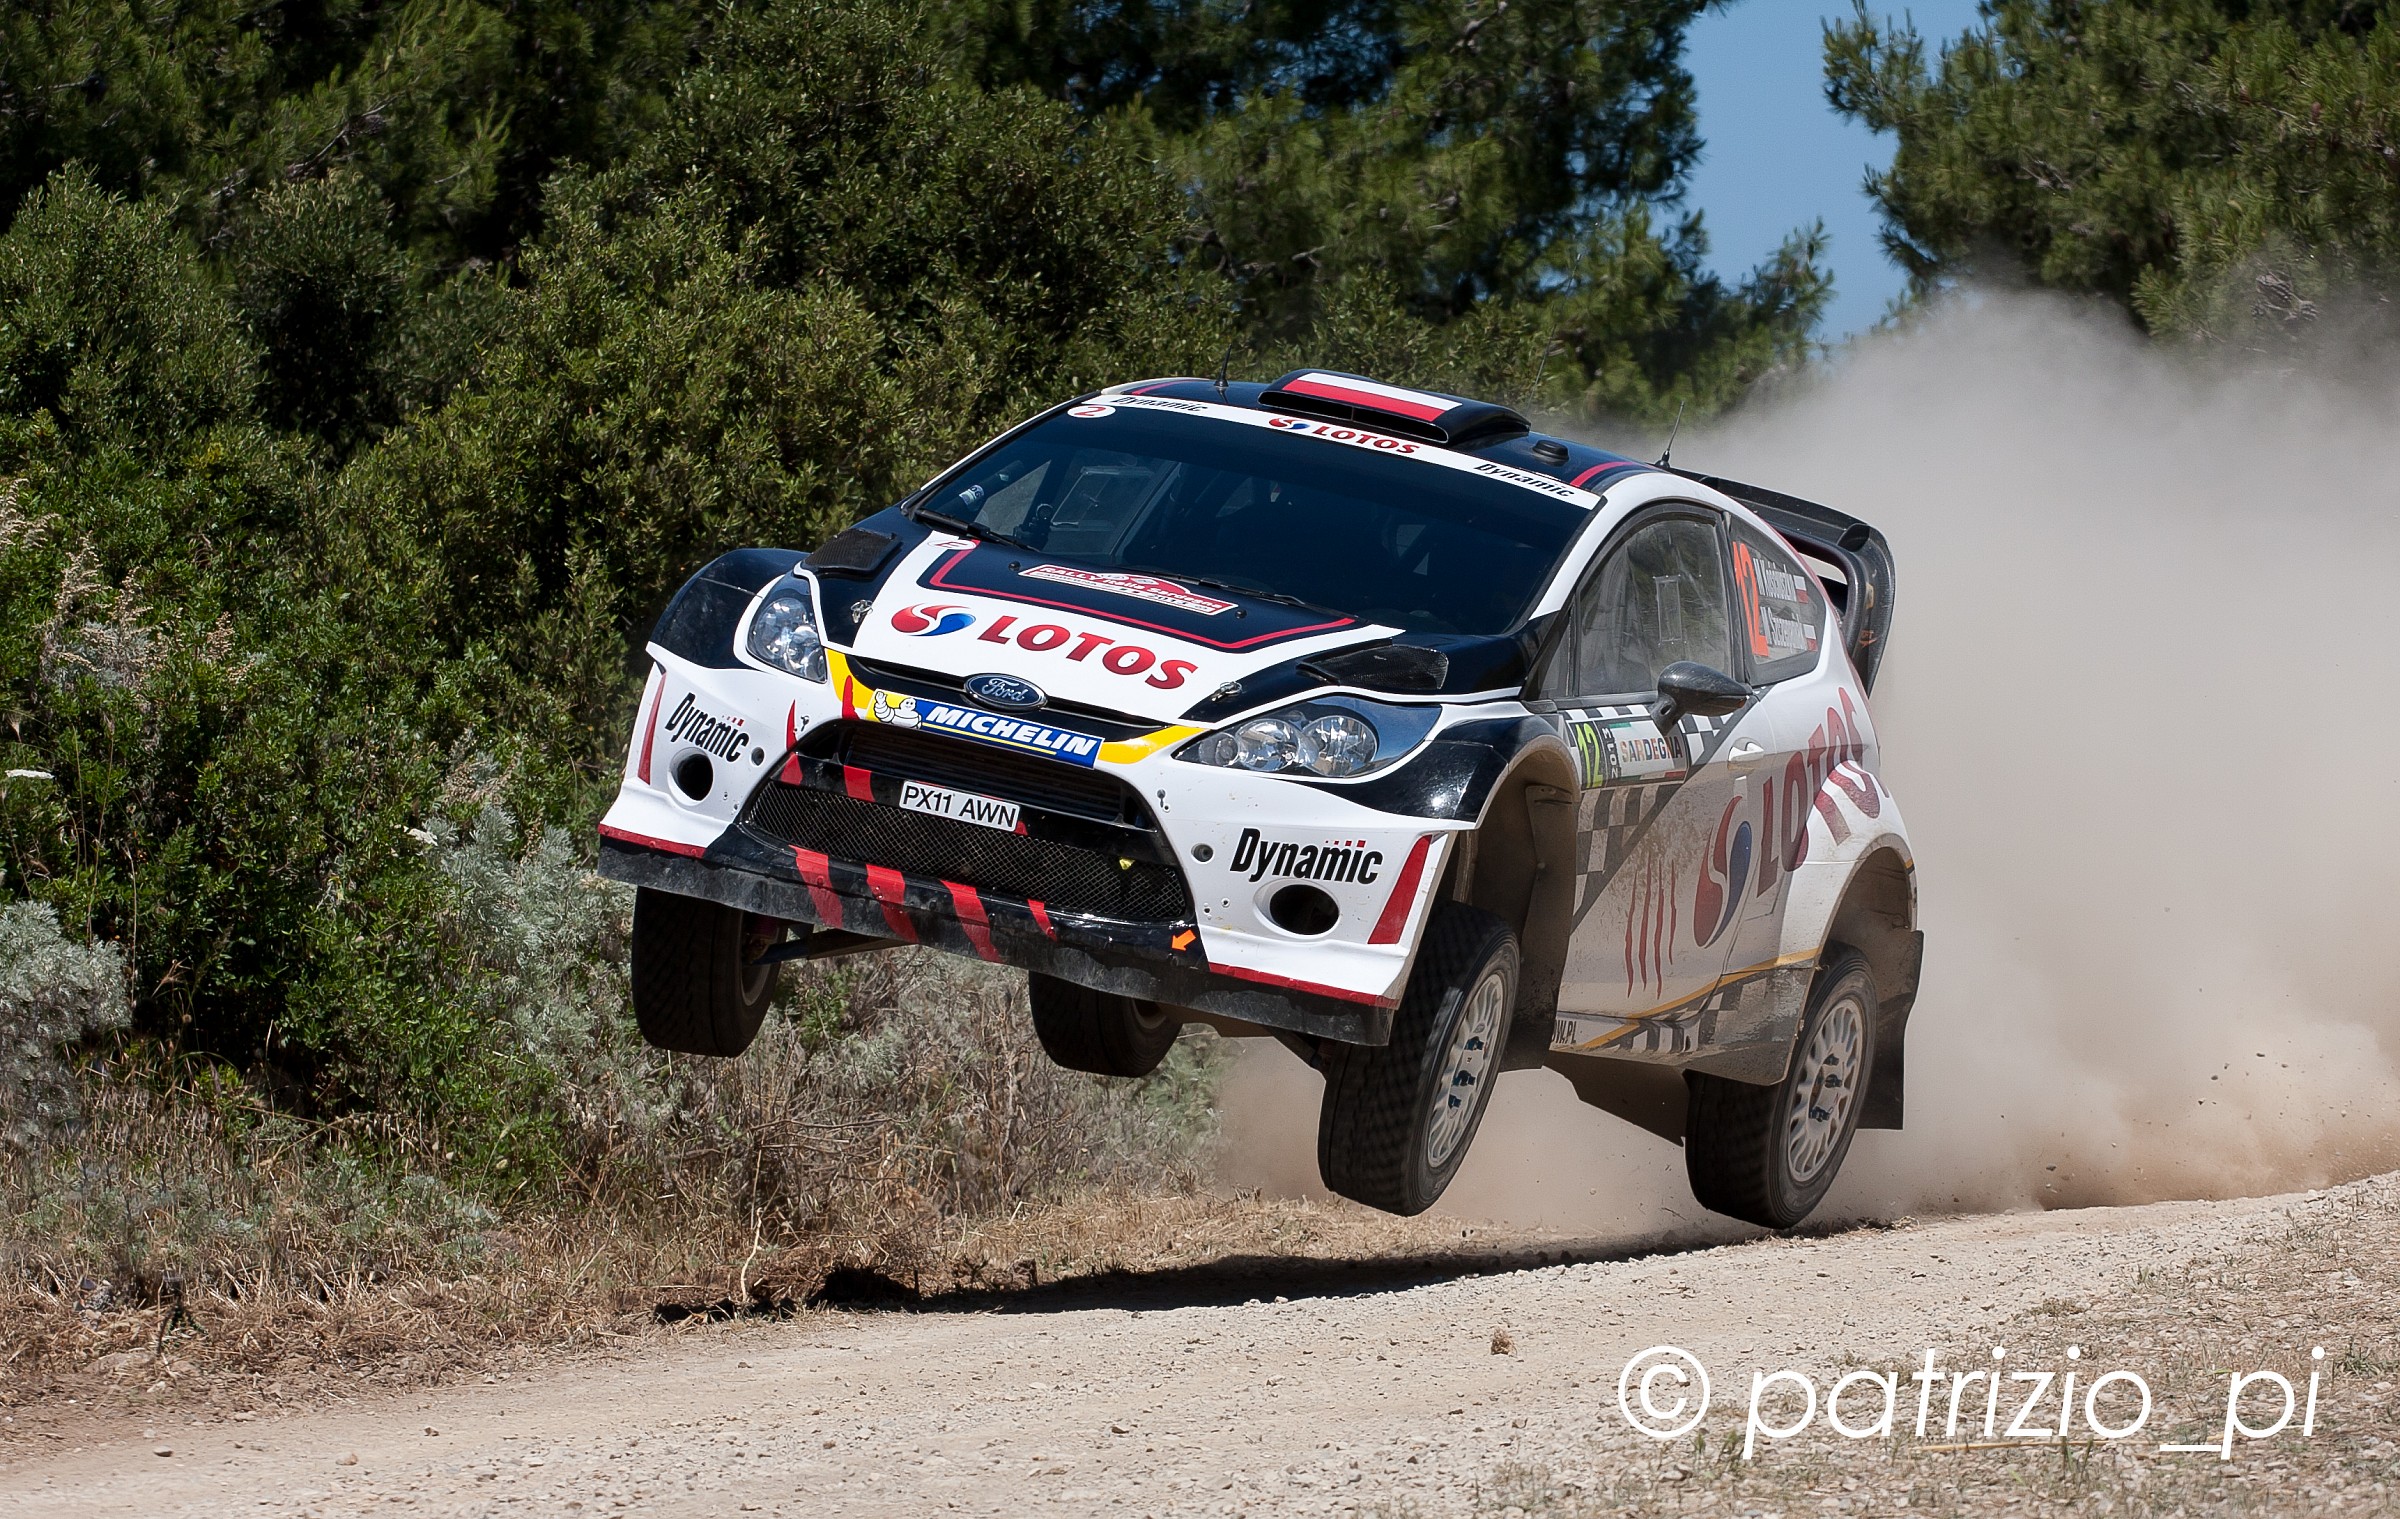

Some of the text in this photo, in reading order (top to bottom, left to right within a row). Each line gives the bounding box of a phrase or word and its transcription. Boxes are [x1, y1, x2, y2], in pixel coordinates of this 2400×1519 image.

[1074, 406, 1107, 417] 2
[1111, 396, 1207, 412] Dynamic
[1312, 425, 1420, 454] LOTOS
[1473, 463, 1575, 497] Dynamic
[1039, 566, 1101, 582] RALLY
[1733, 541, 1769, 657] 12
[977, 615, 1198, 690] LOTOS
[981, 677, 1029, 702] Ford
[665, 692, 750, 762] Dynamic
[925, 705, 1097, 756] MICHELIN
[1575, 722, 1604, 789] 12
[1620, 735, 1683, 763] SARDEGNA
[902, 785, 1016, 828] PX11 AWN
[1757, 687, 1890, 898] LOTOS
[1230, 828, 1384, 884] Dynamic
